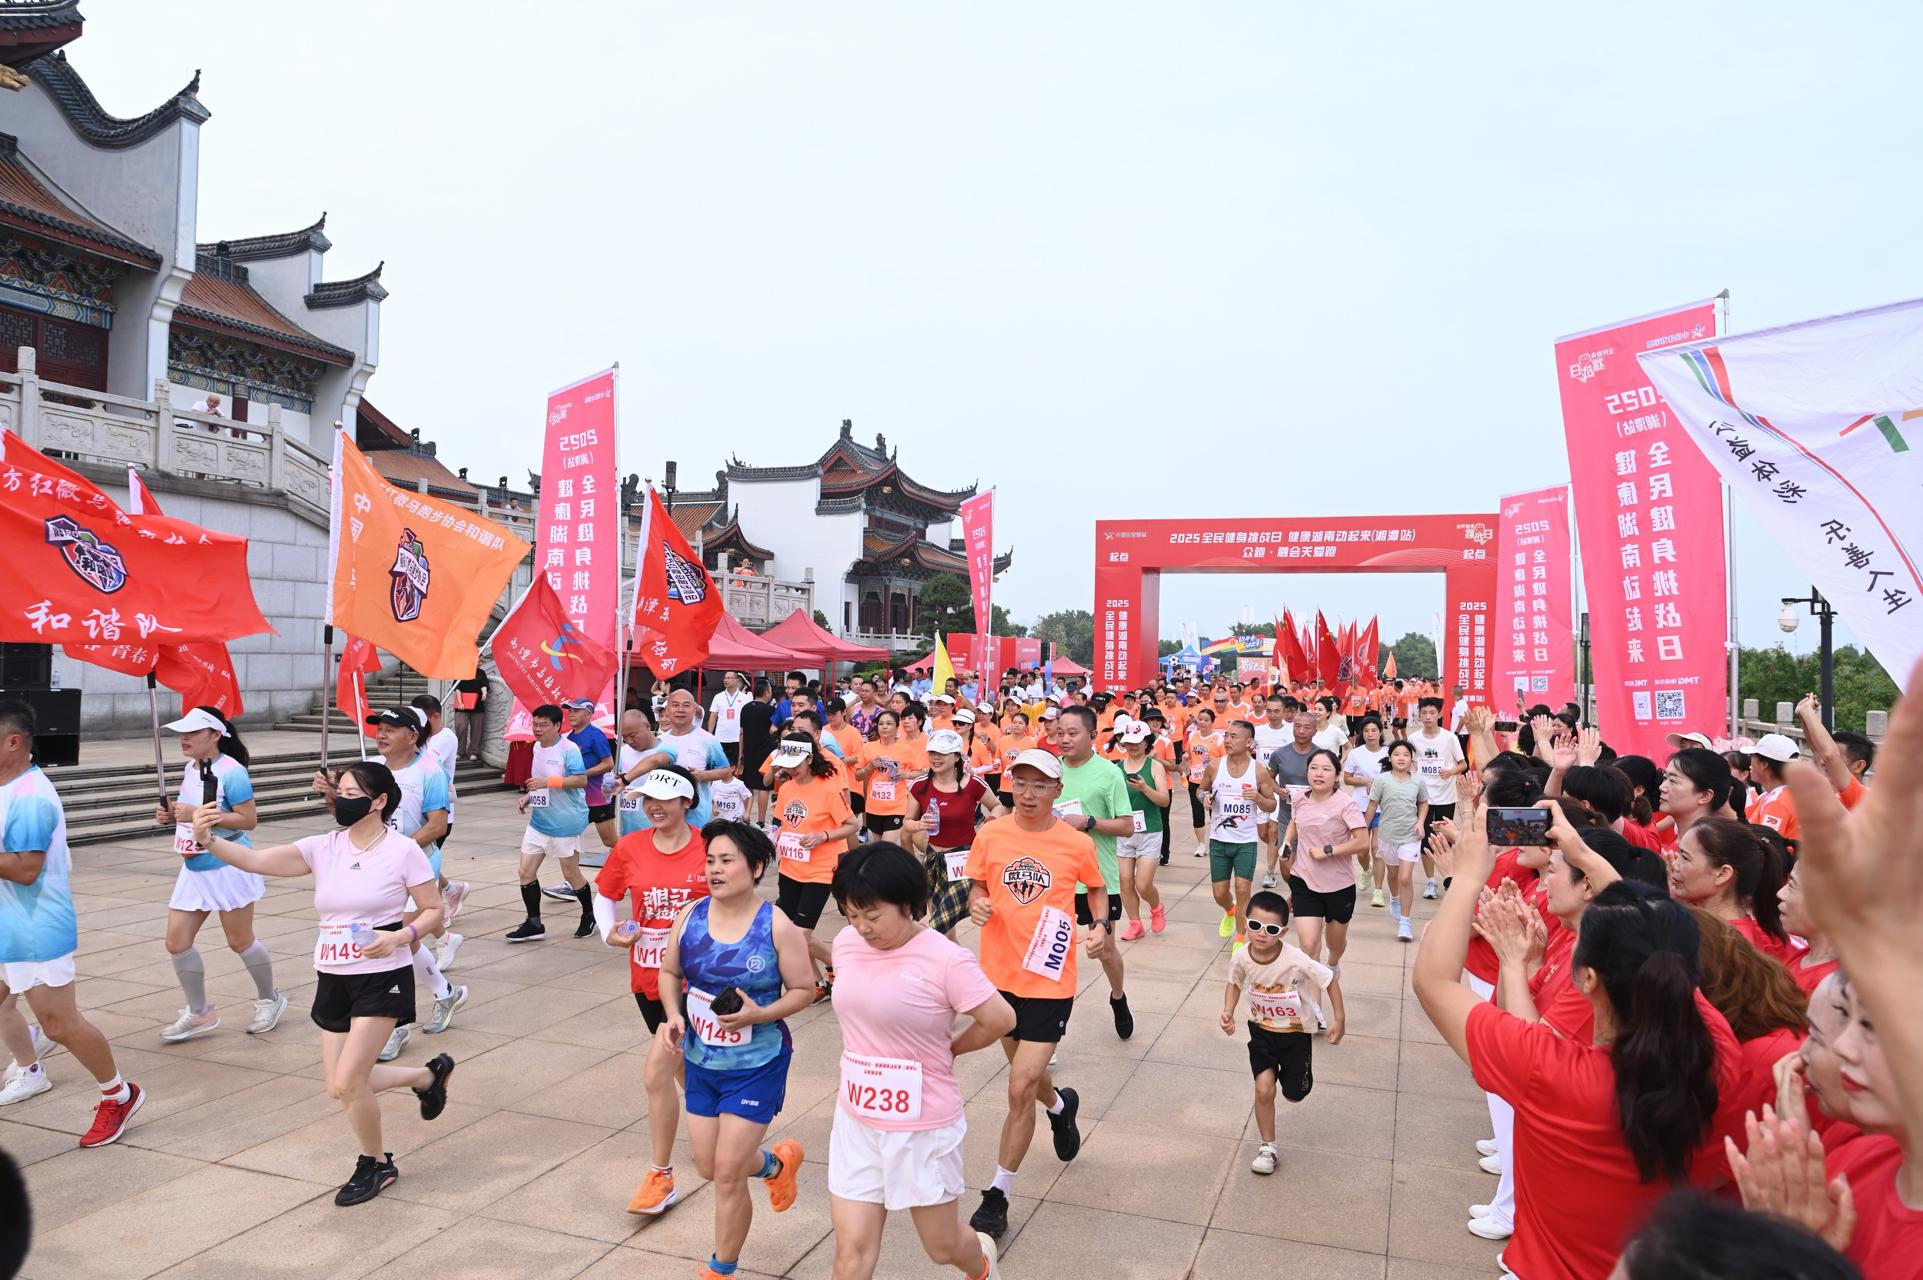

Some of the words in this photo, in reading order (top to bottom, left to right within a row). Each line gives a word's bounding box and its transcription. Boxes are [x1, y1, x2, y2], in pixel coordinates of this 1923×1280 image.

[1109, 552, 1129, 562] 起点
[1463, 549, 1486, 560] 起点
[1460, 602, 1487, 610] 2025
[24, 600, 182, 641] 和谐队
[1104, 611, 1115, 680] 全民健身挑战日
[1118, 611, 1128, 680] 健康湖南动起来
[1474, 614, 1485, 689] 健康湖南动起来
[716, 801, 736, 809] M163
[1223, 803, 1251, 813] M085
[780, 844, 804, 859] W116
[1008, 871, 1045, 884] 微马队
[643, 886, 695, 912] 湘江
[319, 943, 362, 961] W149
[1043, 919, 1073, 972] M005
[1251, 1001, 1297, 1018] W163
[691, 1014, 742, 1044] W145
[847, 1080, 910, 1114] W238
